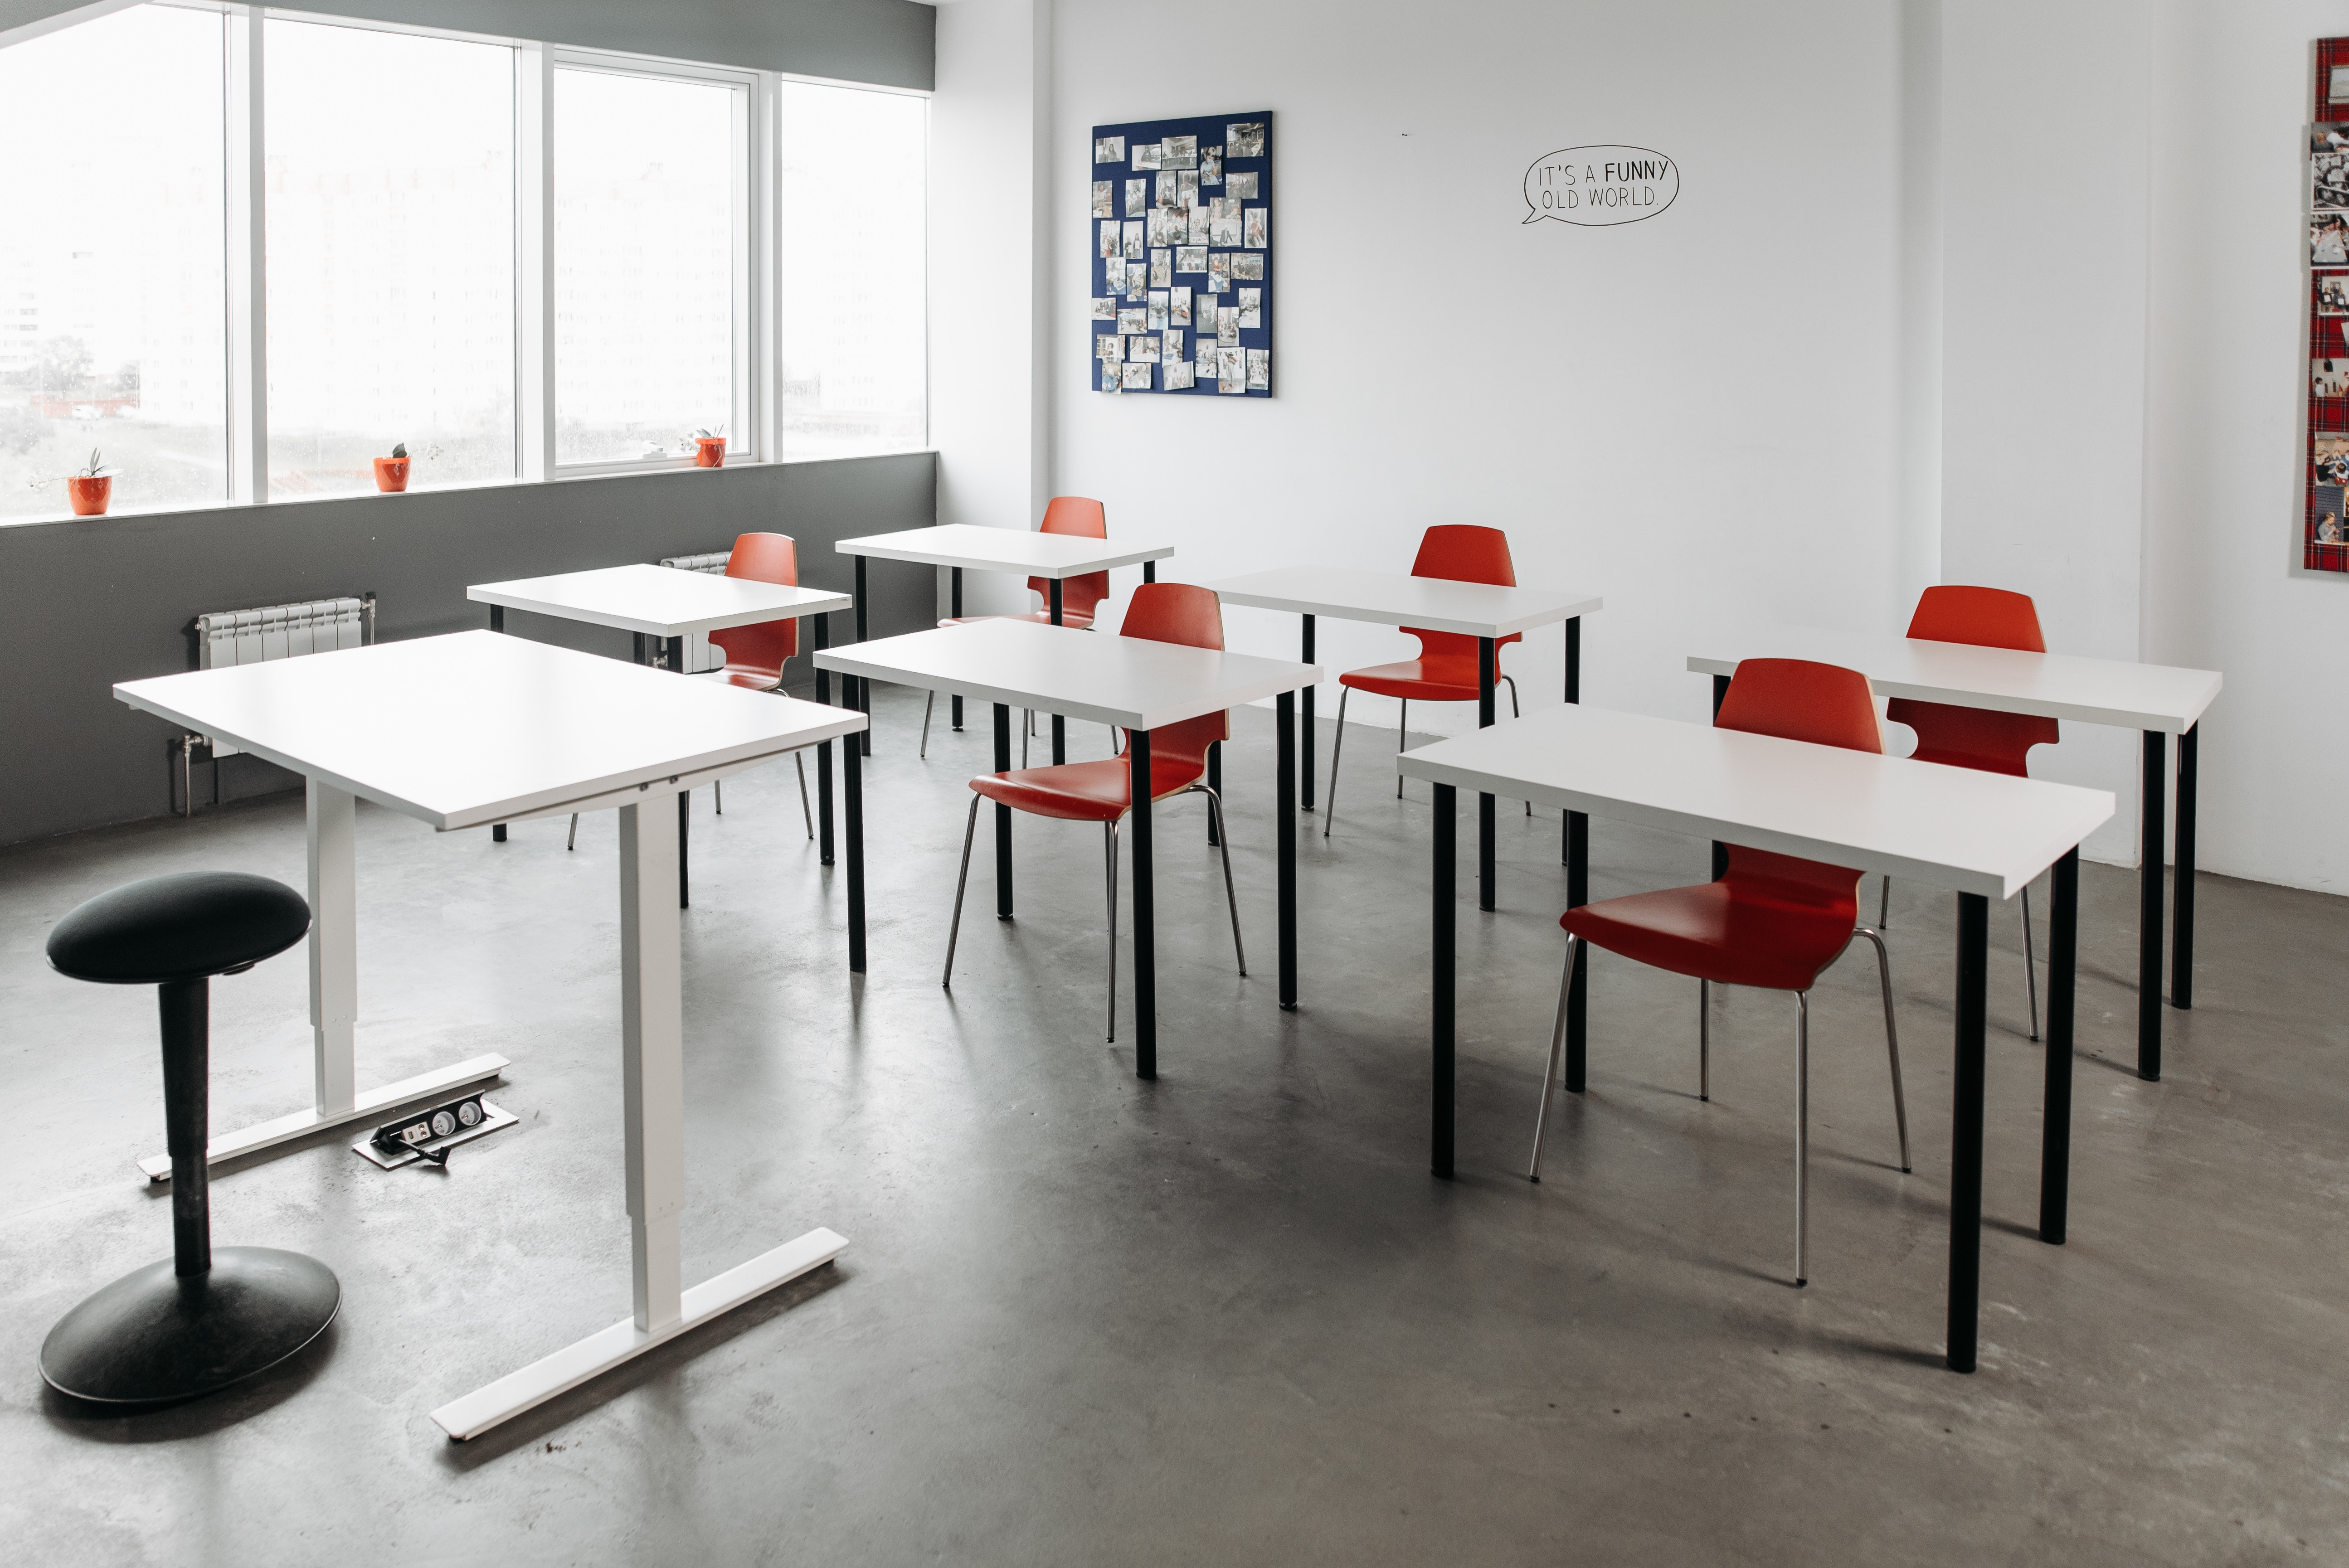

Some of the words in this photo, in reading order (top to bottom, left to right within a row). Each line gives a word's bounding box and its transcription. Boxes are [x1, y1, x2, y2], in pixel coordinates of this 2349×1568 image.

[1539, 165, 1576, 186] IT'S
[1585, 165, 1595, 184] A
[1605, 160, 1668, 182] FUNNY
[1542, 189, 1578, 209] OLD
[1589, 186, 1658, 207] WORLD.
